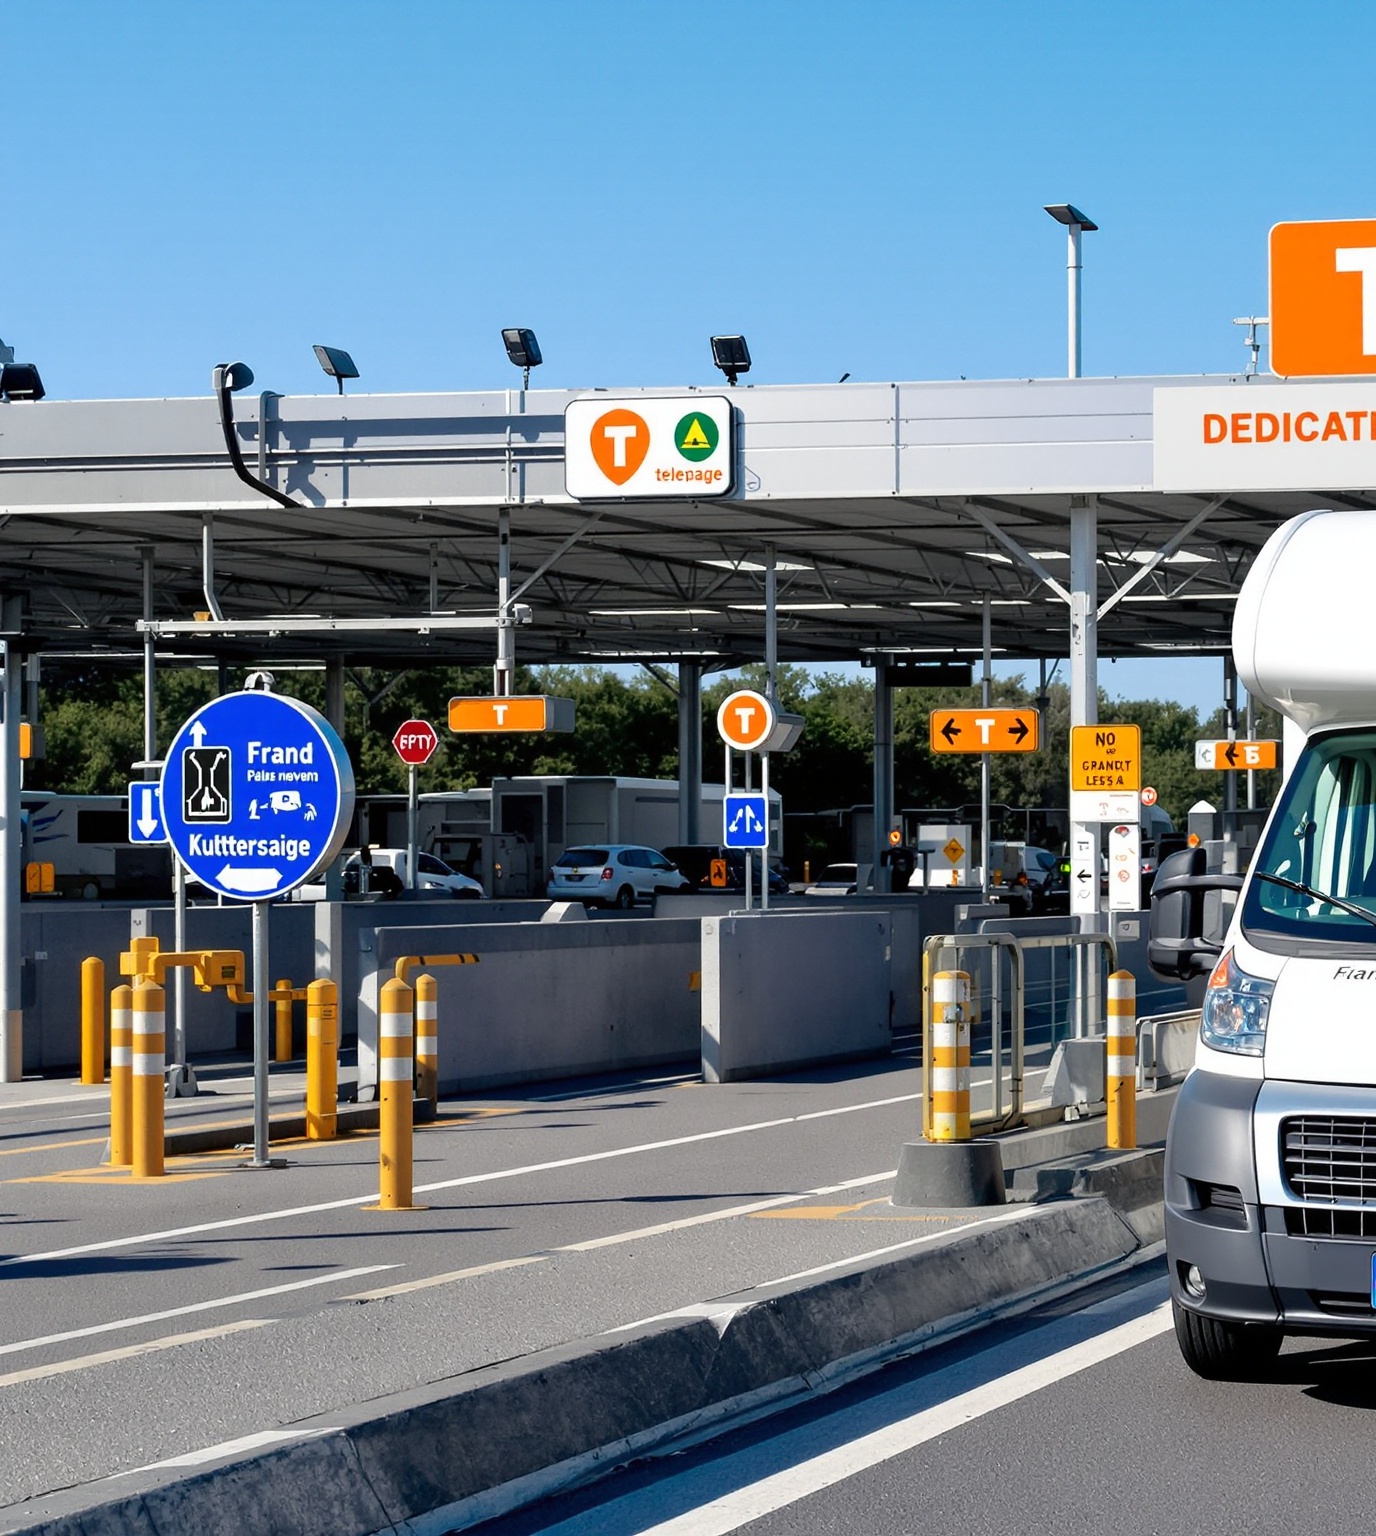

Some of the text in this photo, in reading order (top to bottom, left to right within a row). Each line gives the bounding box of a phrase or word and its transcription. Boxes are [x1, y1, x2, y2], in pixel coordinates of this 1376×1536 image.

[604, 425, 637, 467] T
[655, 467, 723, 484] telepage
[492, 704, 509, 726] T
[734, 707, 755, 734] T
[974, 718, 996, 745] T
[1095, 732, 1116, 747] NO
[247, 741, 313, 765] Frand
